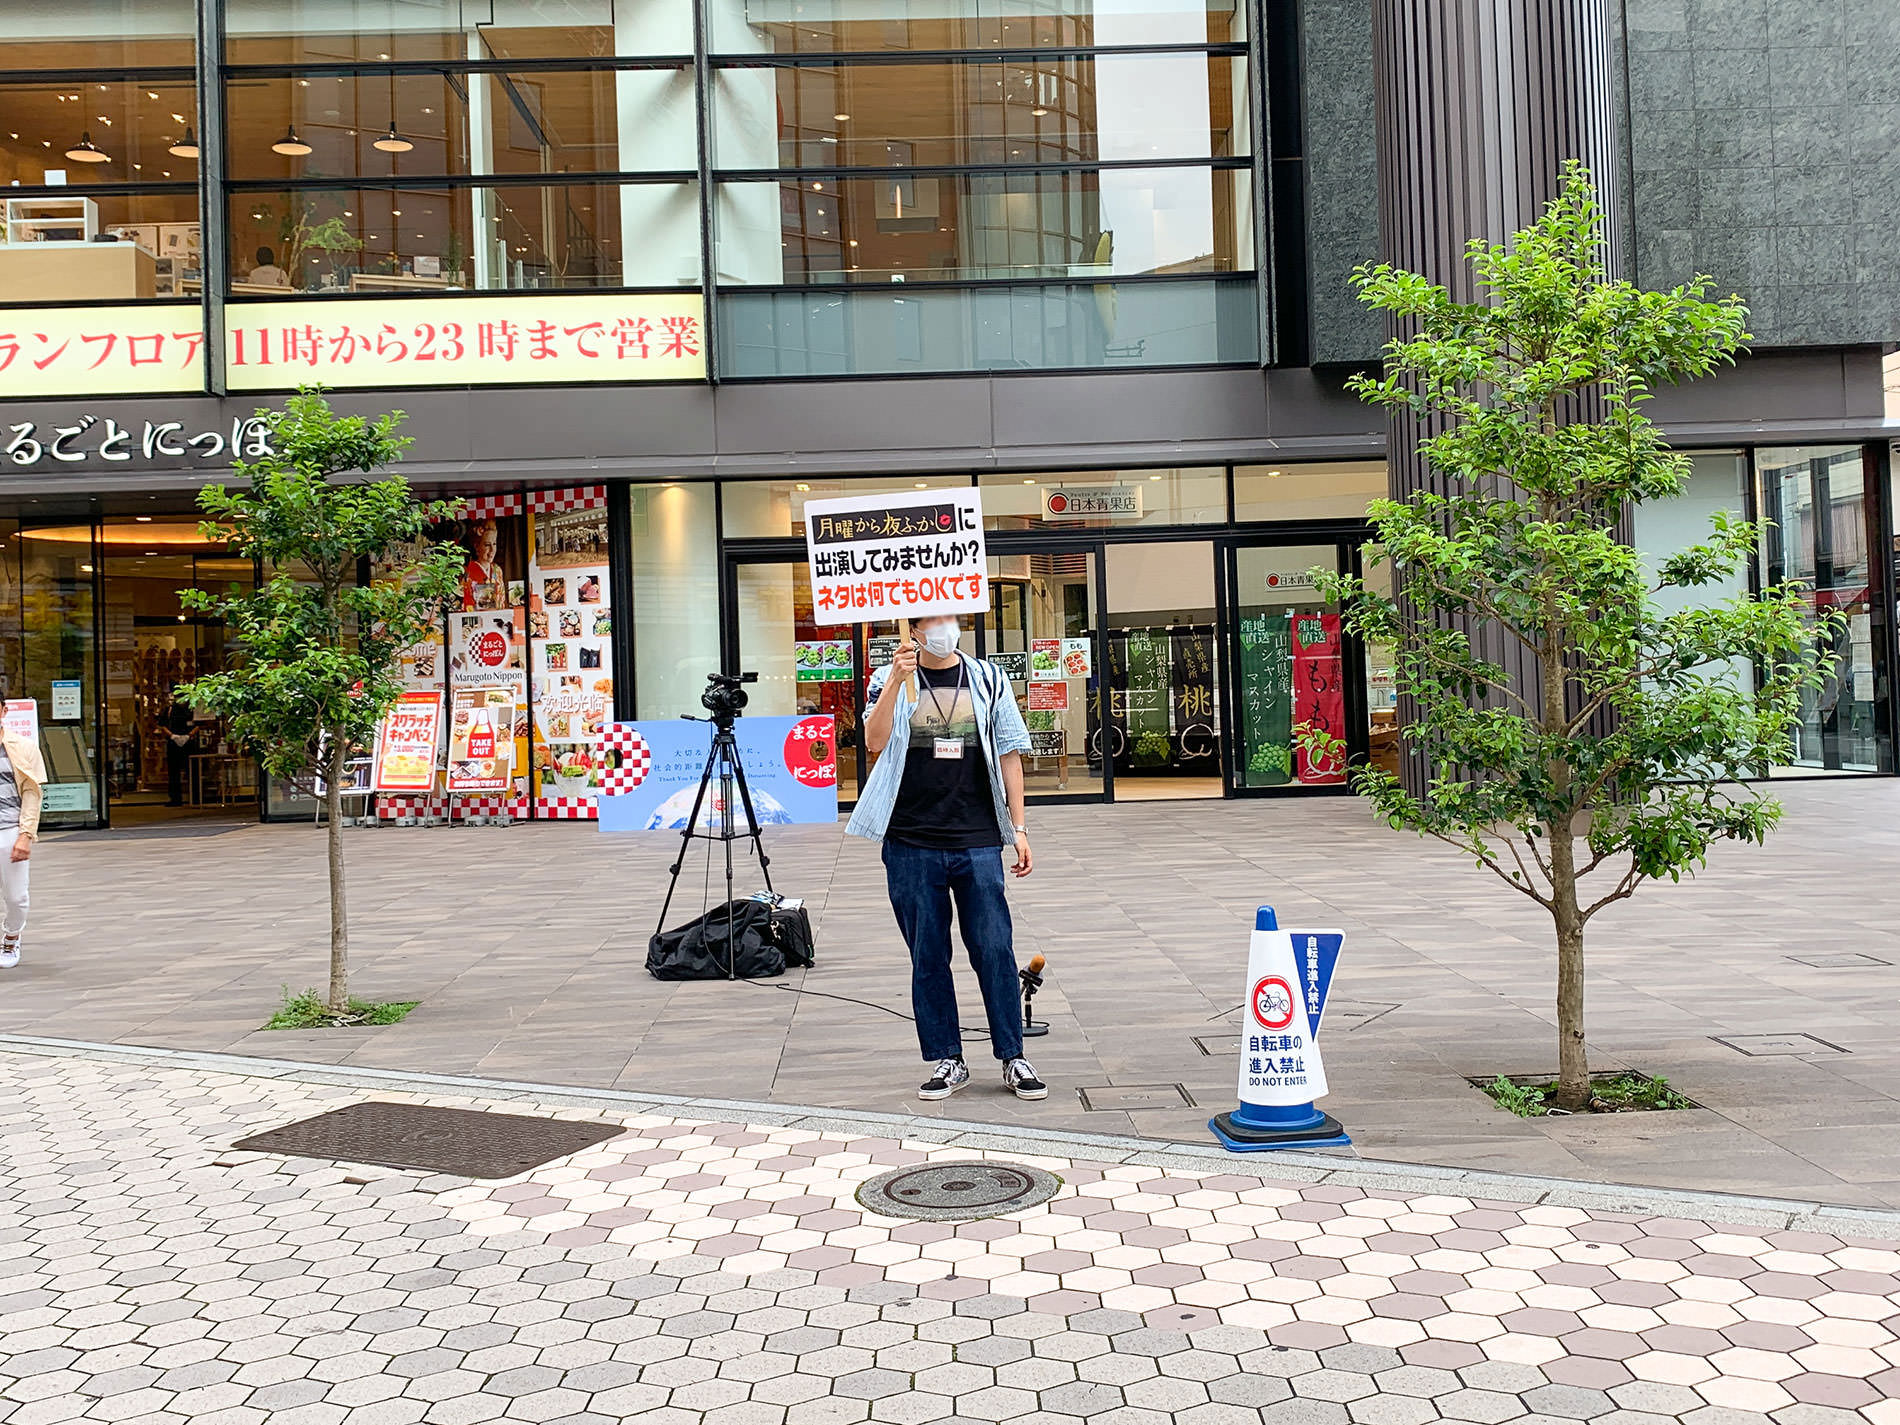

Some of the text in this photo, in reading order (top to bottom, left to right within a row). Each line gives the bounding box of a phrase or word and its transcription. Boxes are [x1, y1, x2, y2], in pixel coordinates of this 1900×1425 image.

[230, 315, 700, 367] 11時から23時まで営業
[6, 410, 290, 465] るごとにっぽ
[1070, 496, 1137, 512] 日本青果店
[814, 540, 980, 578] 出演してみませんか?
[1280, 575, 1317, 586] 日本青果
[817, 572, 983, 611] ネタは何でもOKです
[1240, 620, 1266, 632] 産地
[1297, 619, 1322, 632] 産地
[1245, 632, 1271, 644] 直送
[1302, 631, 1327, 643] 直送
[1275, 633, 1290, 692] 山梨県産
[454, 671, 523, 684] Marugoto Nippon
[1177, 684, 1213, 719] 桃
[1308, 659, 1329, 732] もも
[1246, 673, 1262, 741] マスカット
[391, 714, 433, 728] スクラッチ
[388, 729, 432, 742] キャンペーン
[793, 722, 833, 740] まるご
[470, 739, 492, 747] TAKE
[472, 747, 490, 755] OUT
[792, 763, 837, 780] にっぽ
[1305, 936, 1321, 1016] 自転車進入禁止
[1249, 1034, 1303, 1052] 自転車の
[1248, 1057, 1306, 1075] 進入禁止
[1249, 1075, 1308, 1087] DO NOT ENTER
